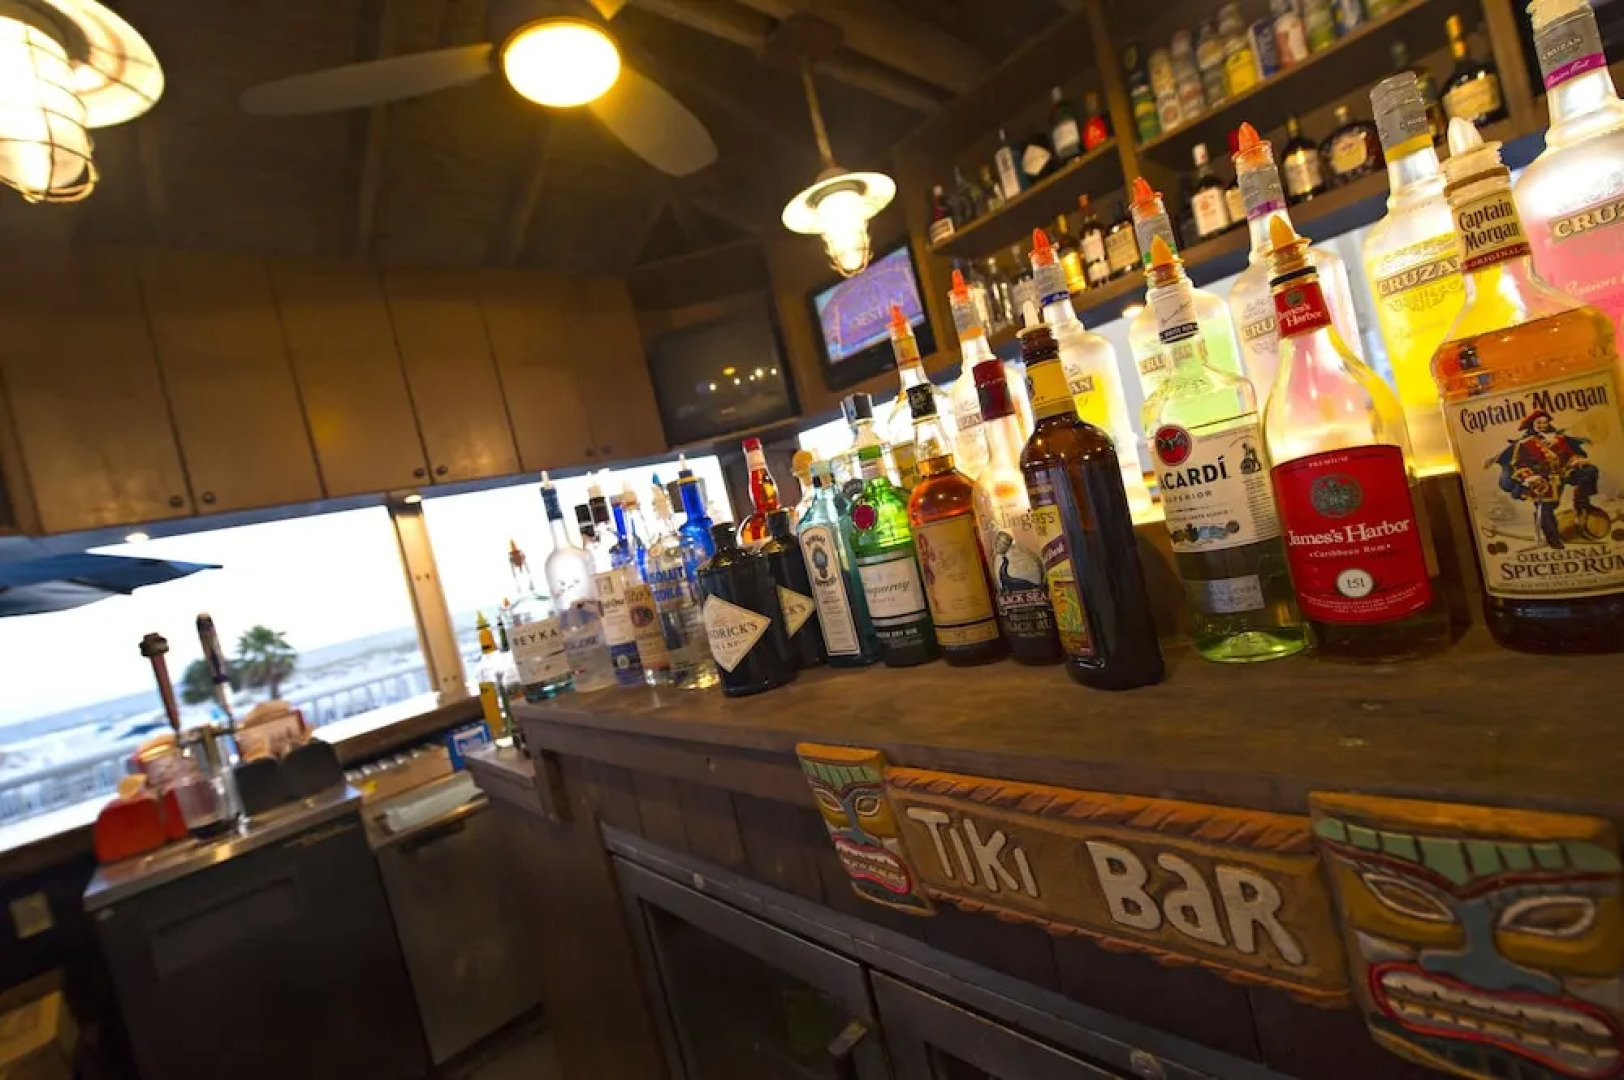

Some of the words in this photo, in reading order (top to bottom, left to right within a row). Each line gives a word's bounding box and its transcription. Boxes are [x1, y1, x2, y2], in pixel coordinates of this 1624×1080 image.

[1459, 199, 1513, 232] Captain
[1464, 222, 1520, 256] Morgan
[1286, 310, 1323, 328] Harbor
[1460, 399, 1526, 433] Captain
[1526, 385, 1609, 414] Morgan
[1288, 528, 1343, 546] James's
[1346, 518, 1410, 543] Harbor
[1314, 549, 1361, 558] Caribbean
[1364, 543, 1386, 553] Rum
[1516, 545, 1612, 562] ORIGINAL
[1501, 561, 1580, 580] SPICED
[1345, 578, 1365, 589] 151
